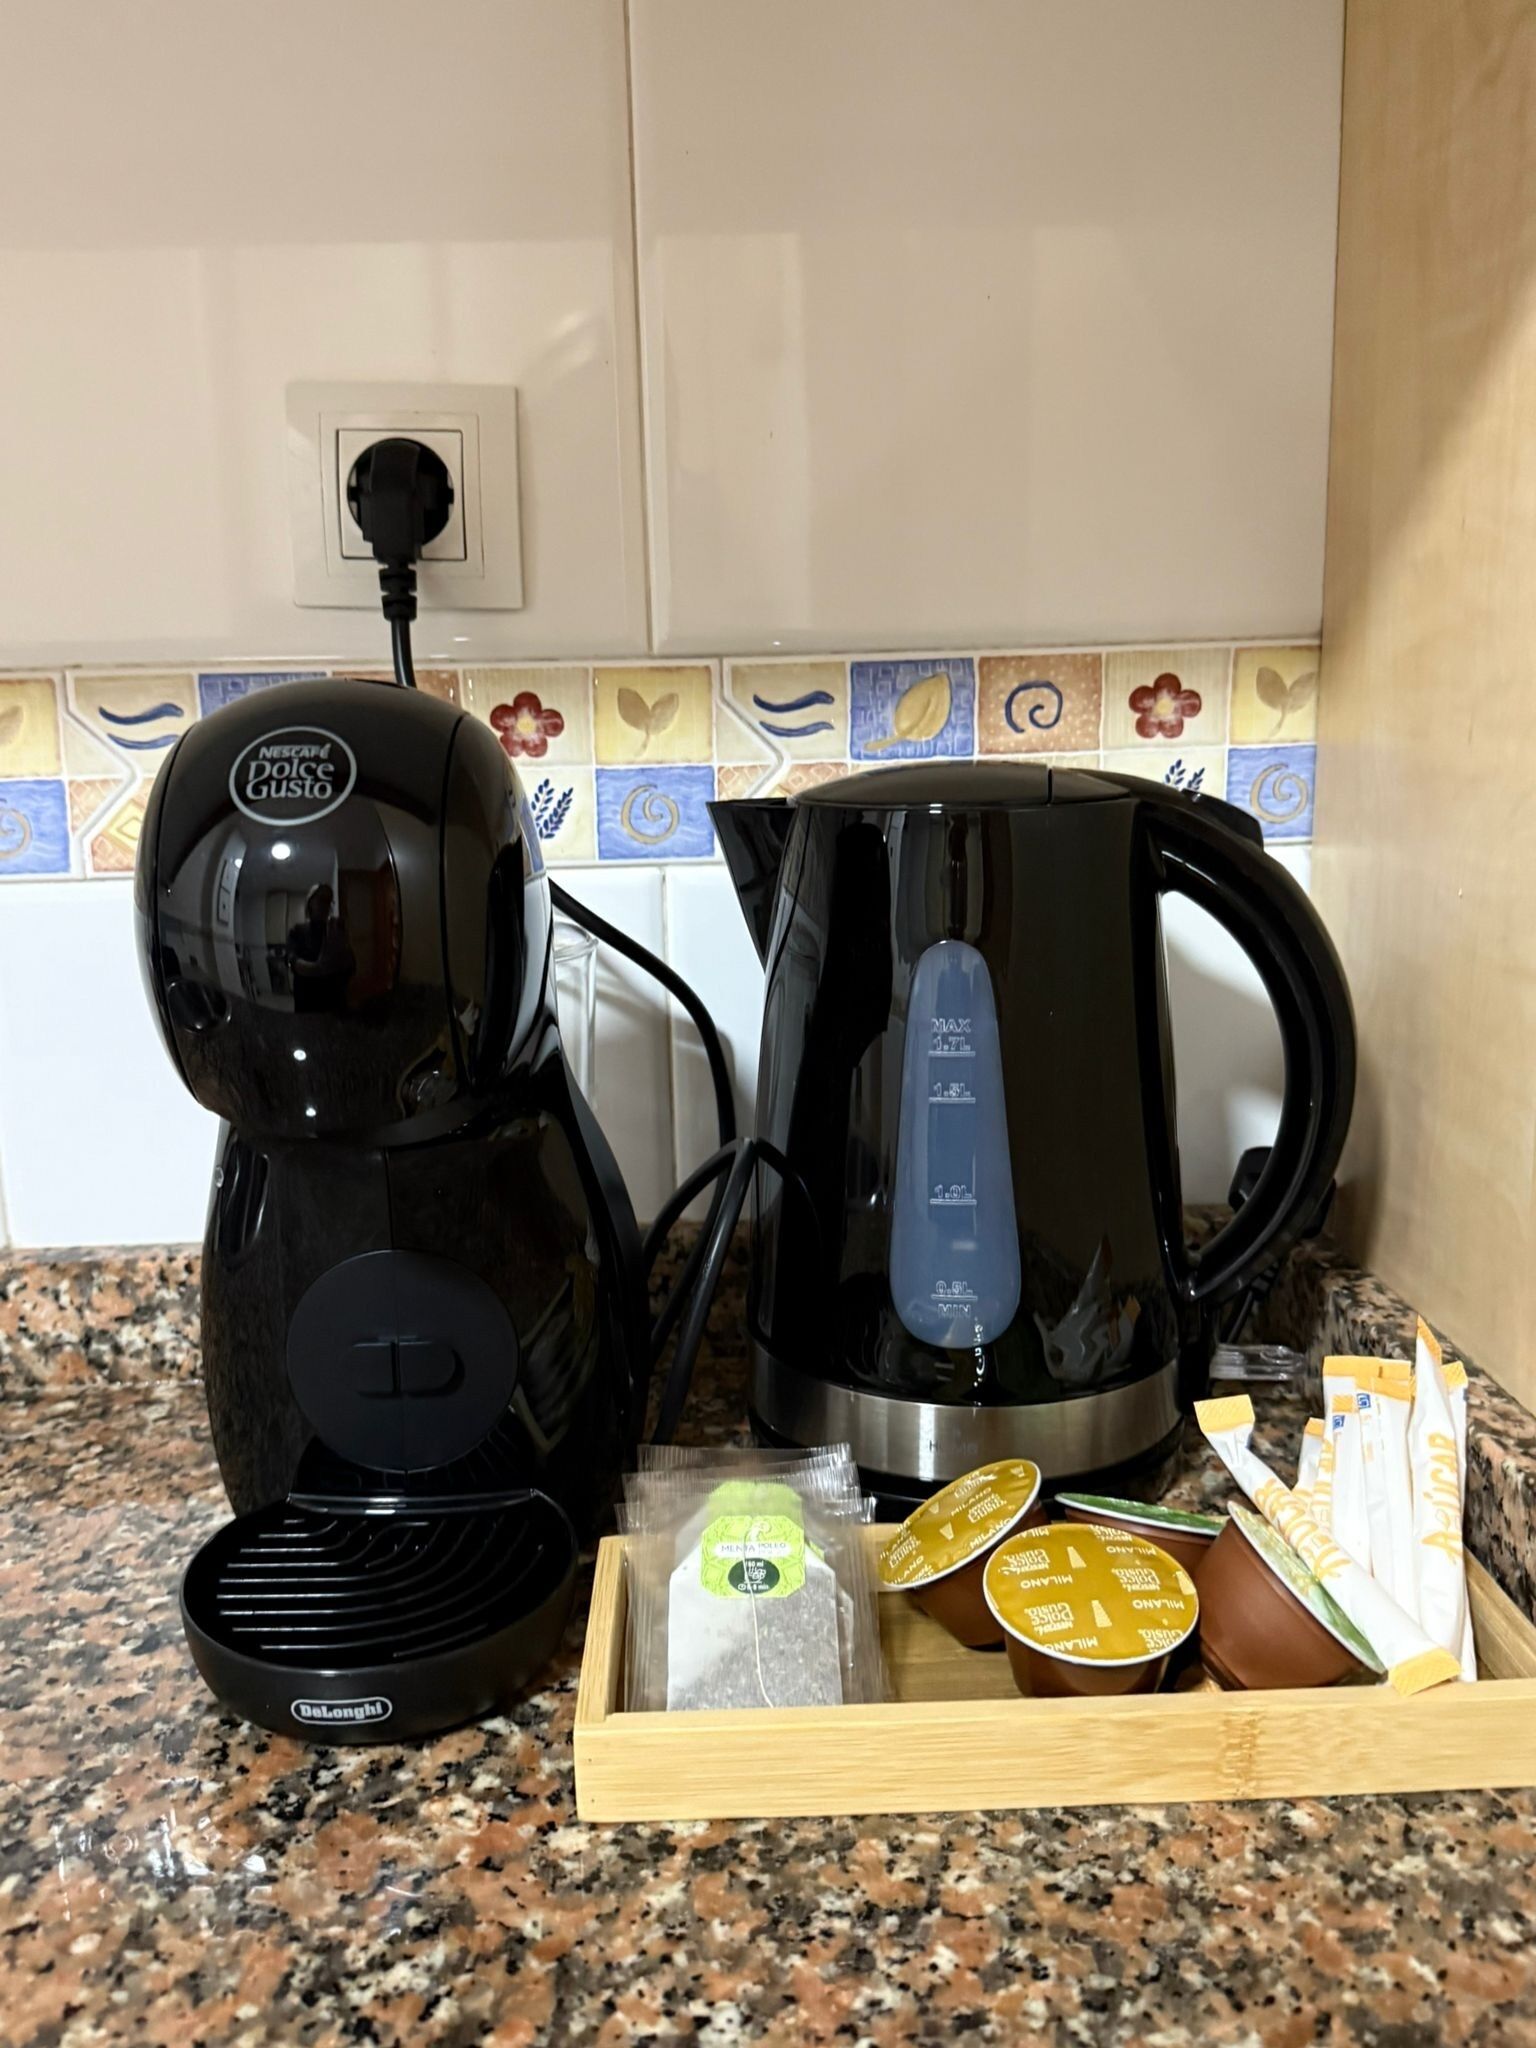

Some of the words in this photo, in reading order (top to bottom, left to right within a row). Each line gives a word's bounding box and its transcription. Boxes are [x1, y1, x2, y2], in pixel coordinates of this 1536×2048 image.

[259, 742, 332, 759] NESCAFÉ
[248, 759, 335, 781] Dolce
[246, 776, 332, 800] Gusto
[931, 1018, 971, 1033] MAX
[933, 1036, 971, 1051] 1.7L
[933, 1082, 971, 1097] 1.5L
[934, 1184, 973, 1198] 1.0L
[935, 1280, 974, 1295] 0.5L
[938, 1303, 972, 1318] MIN
[1106, 1545, 1157, 1556] MILANO
[1020, 1574, 1073, 1589] MILANO
[1132, 1599, 1184, 1610] MILANO
[300, 1703, 383, 1719] DeLonghi
